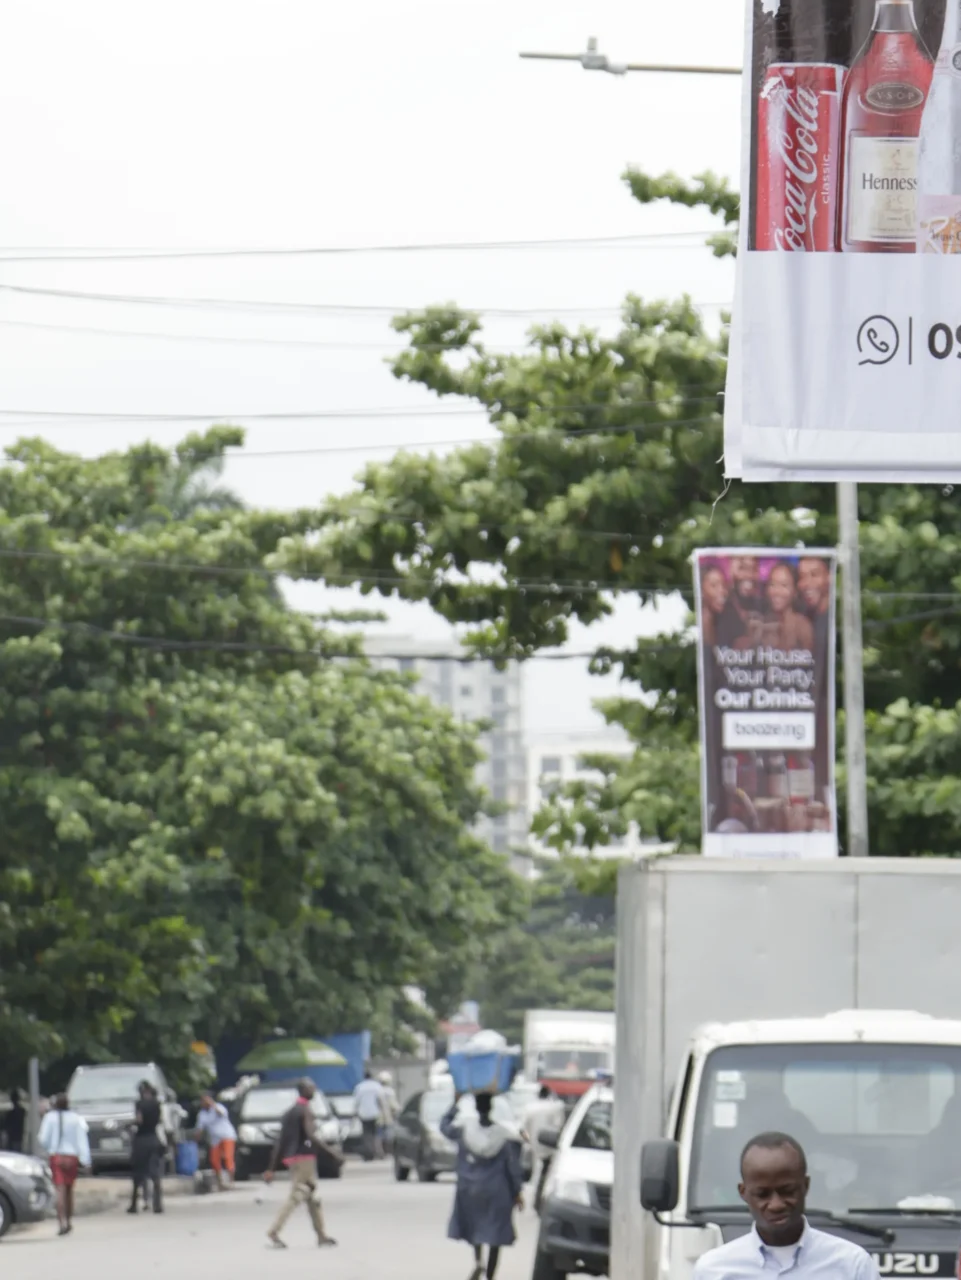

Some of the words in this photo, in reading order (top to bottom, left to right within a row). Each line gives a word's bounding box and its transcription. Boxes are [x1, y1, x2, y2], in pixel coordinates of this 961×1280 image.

[820, 154, 831, 205] classic
[713, 645, 755, 666] Your
[756, 645, 815, 666] House.
[724, 666, 766, 687] Your
[714, 687, 751, 710] Our
